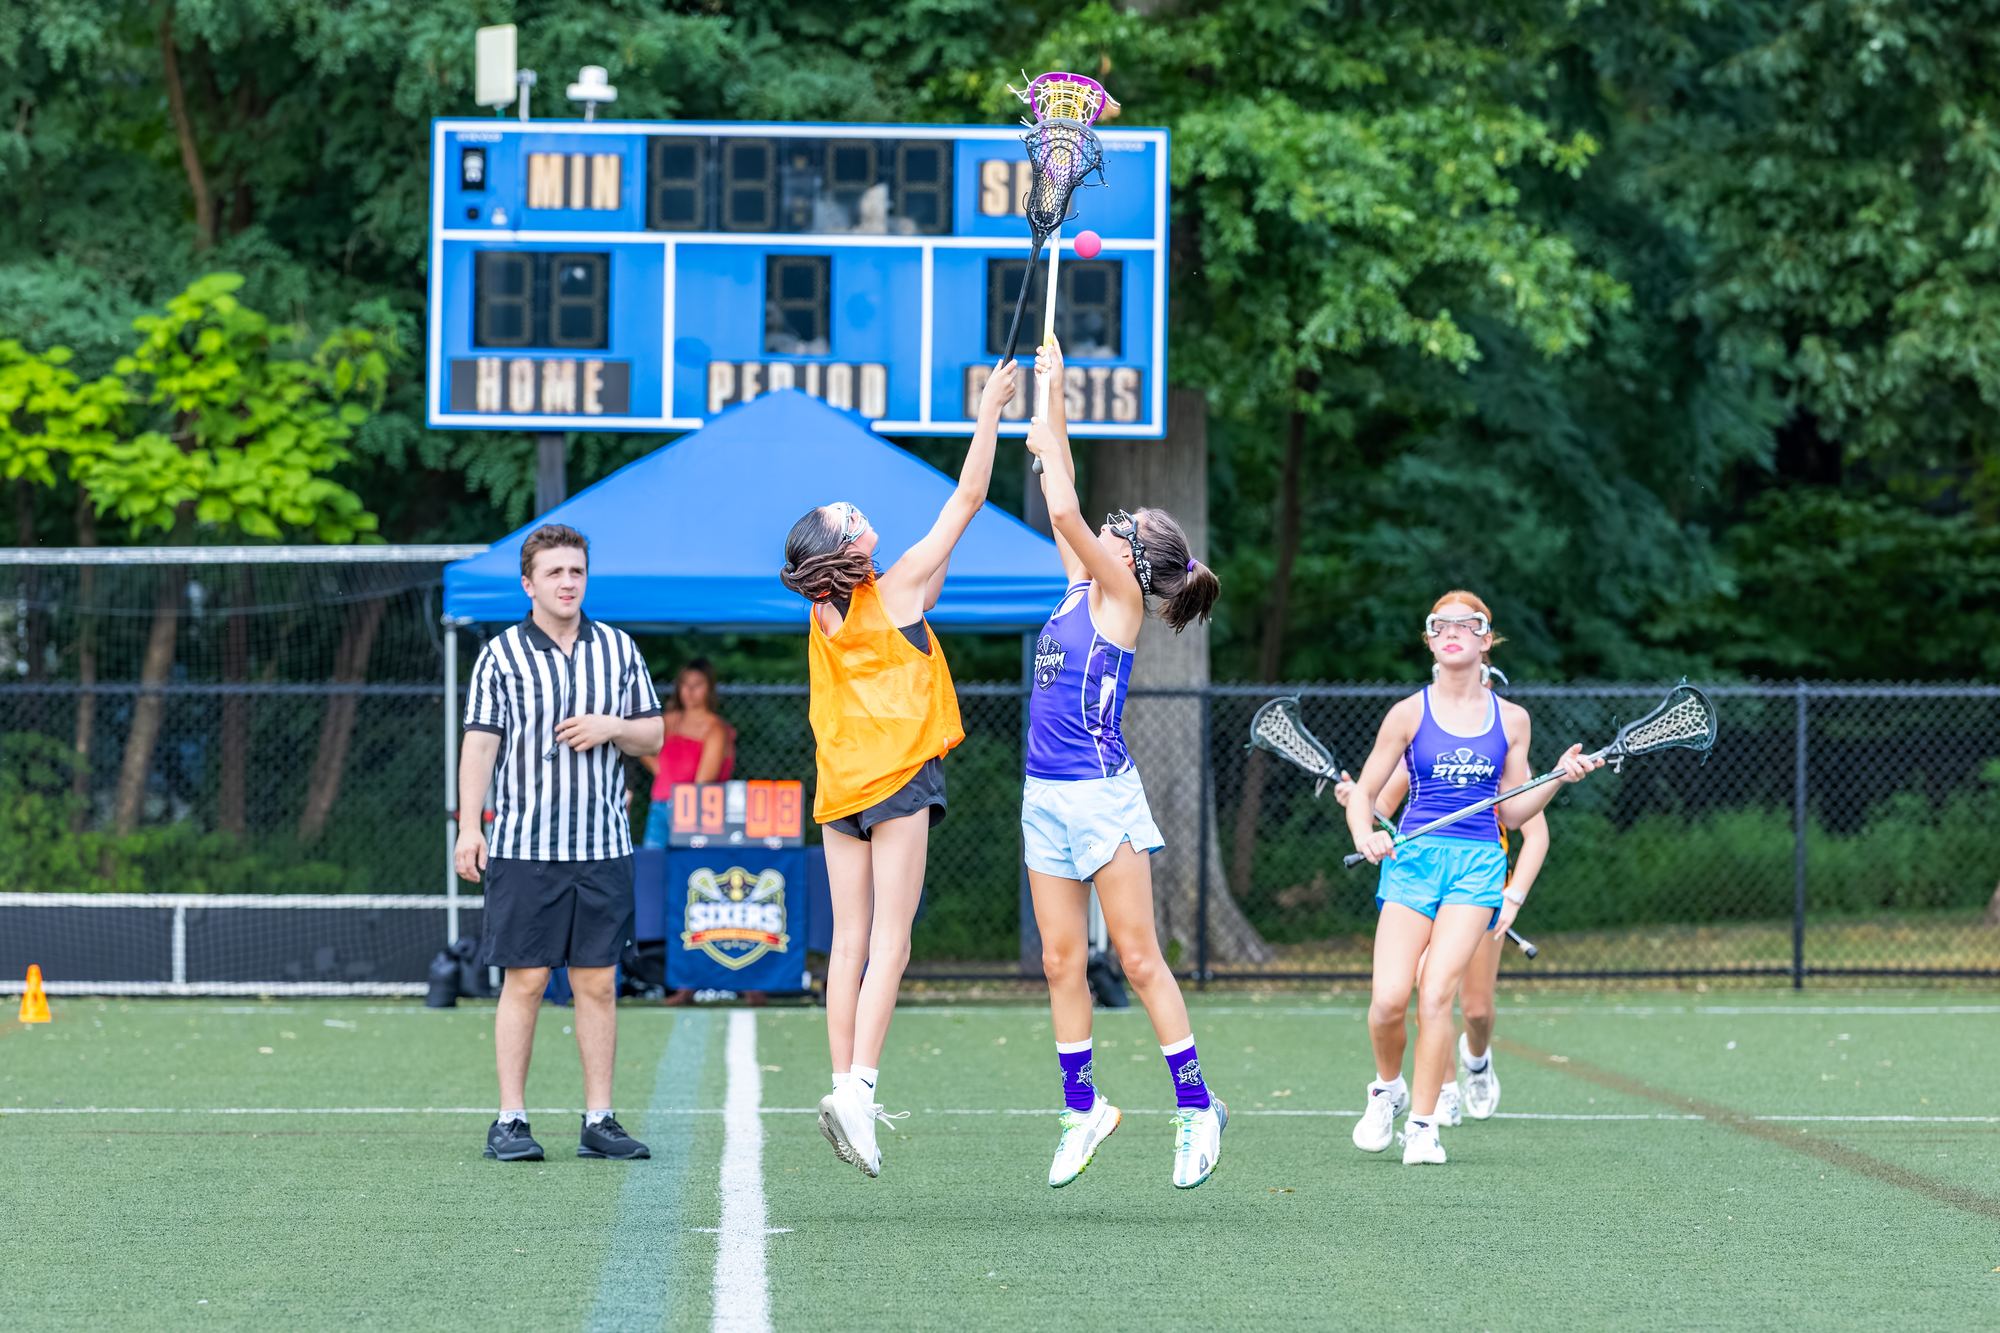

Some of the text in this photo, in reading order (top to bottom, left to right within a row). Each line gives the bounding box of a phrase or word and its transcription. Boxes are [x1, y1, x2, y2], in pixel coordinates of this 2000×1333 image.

[528, 154, 620, 210] MIN
[476, 357, 604, 414] HOME
[967, 364, 1139, 422] GUSTS
[1034, 651, 1067, 672] STORM
[1431, 763, 1496, 779] STORM
[688, 901, 783, 934] SIXERS
